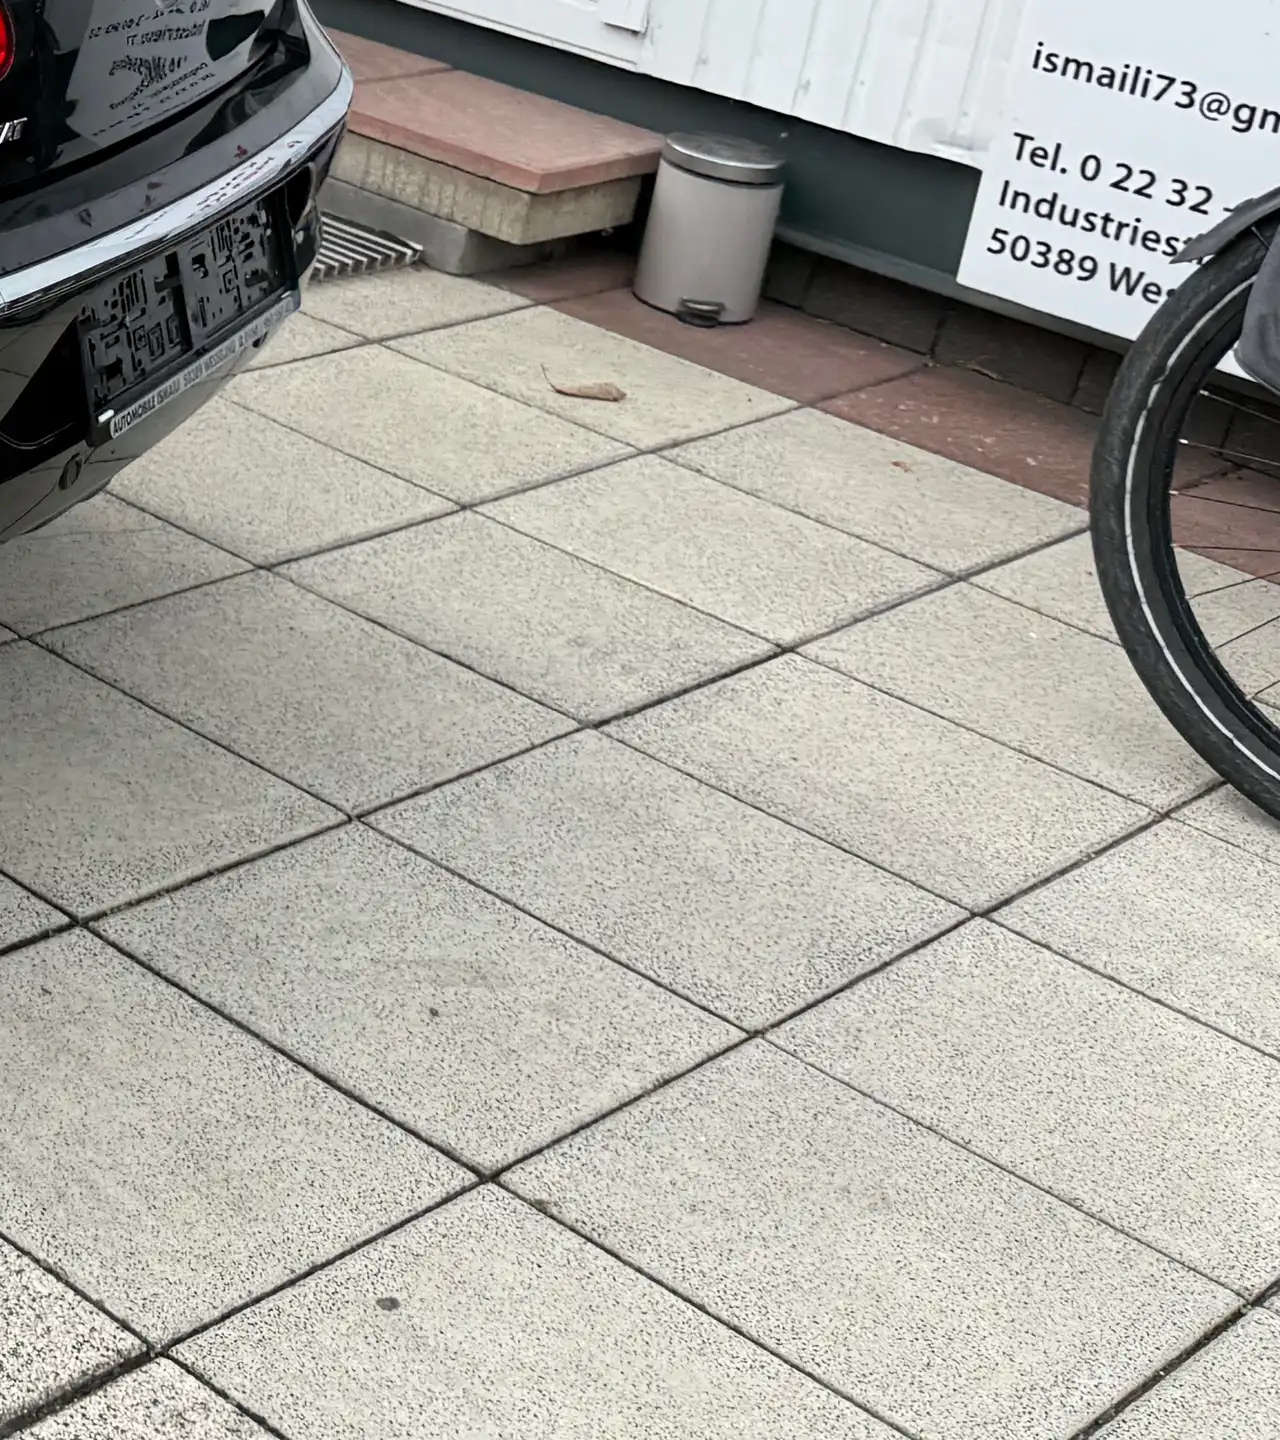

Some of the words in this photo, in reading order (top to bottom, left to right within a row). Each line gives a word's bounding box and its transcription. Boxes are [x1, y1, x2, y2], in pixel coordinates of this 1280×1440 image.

[1013, 132, 1067, 175] Tel.
[1080, 154, 1102, 182] 0
[1109, 162, 1157, 199] 22
[1165, 178, 1213, 215] 32
[986, 228, 1098, 282] 50389
